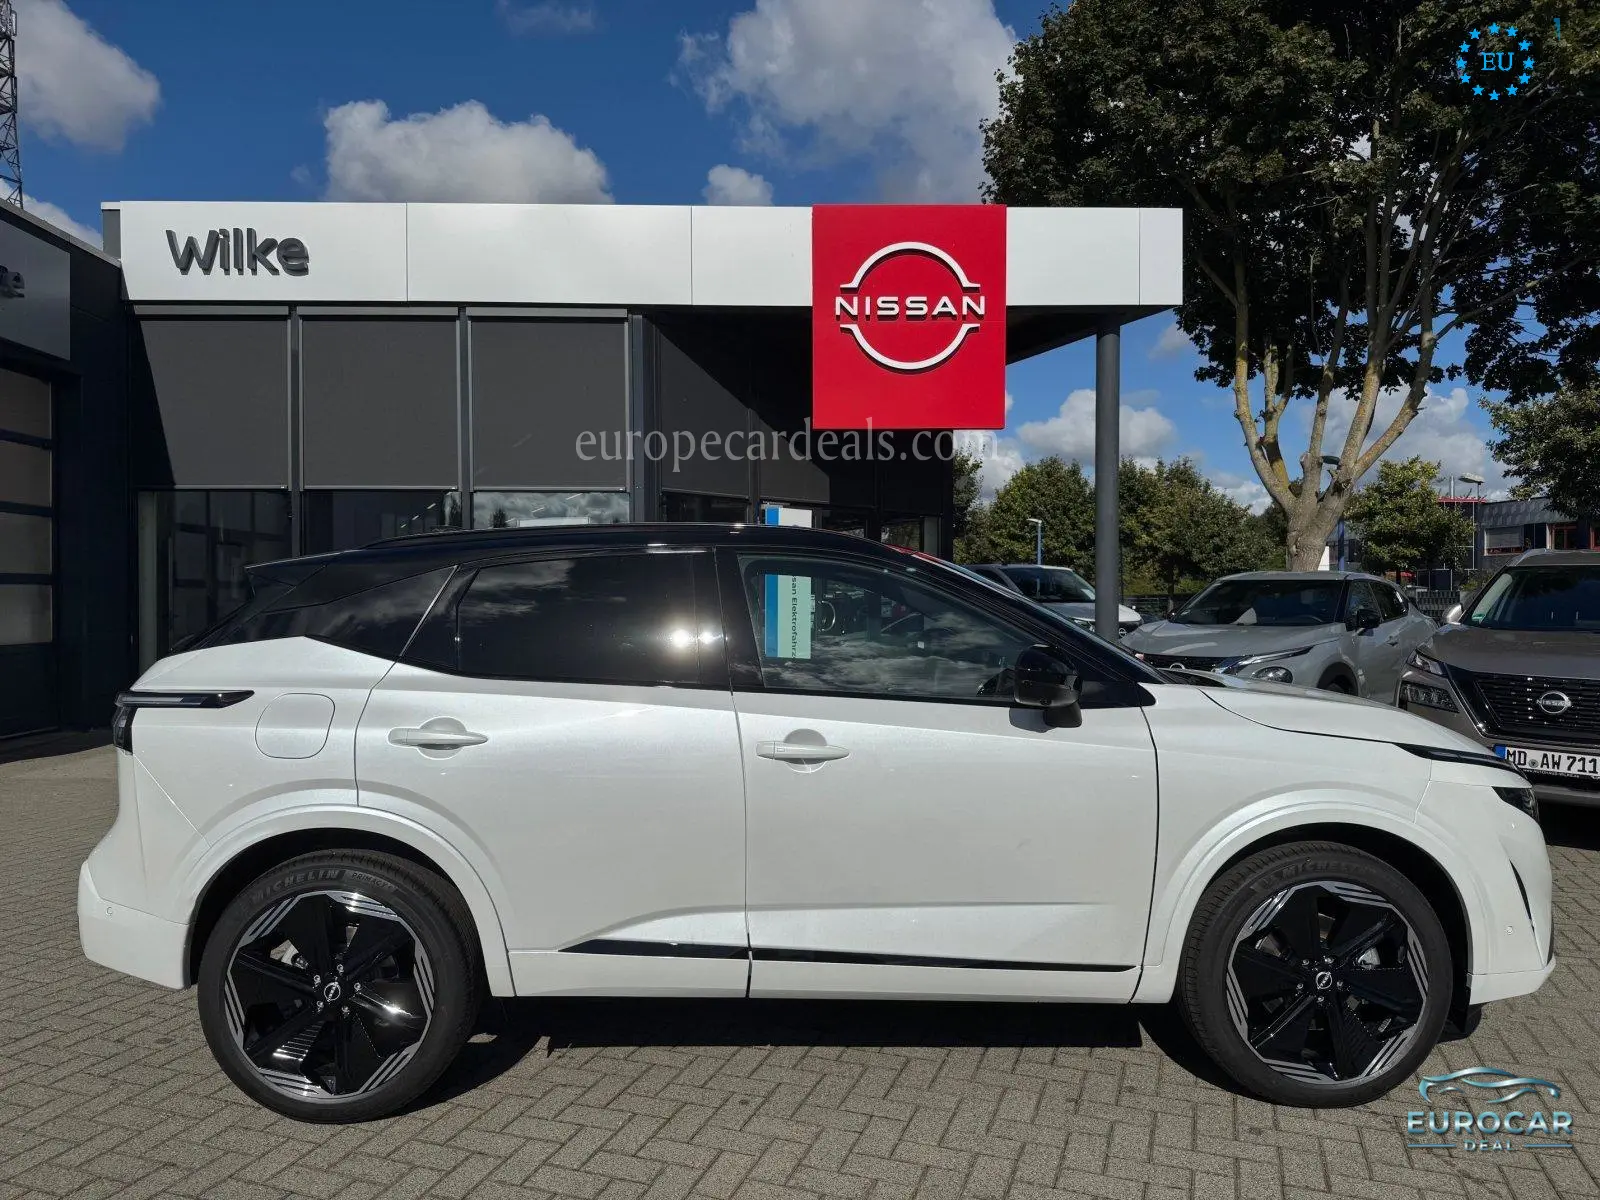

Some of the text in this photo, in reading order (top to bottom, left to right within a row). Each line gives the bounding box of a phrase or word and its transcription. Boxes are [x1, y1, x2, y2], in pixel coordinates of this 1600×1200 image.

[166, 227, 310, 277] Wilke
[835, 294, 986, 318] NISSAN
[1506, 749, 1599, 774] MD AW 711
